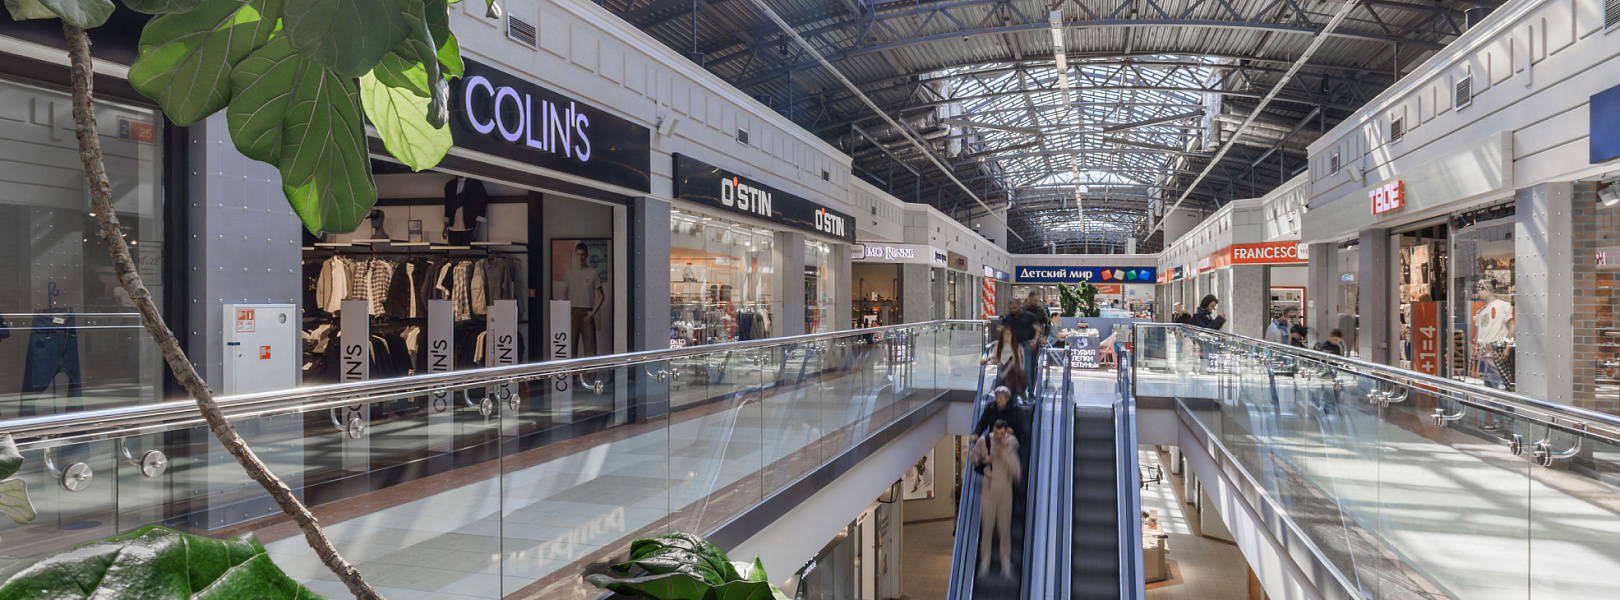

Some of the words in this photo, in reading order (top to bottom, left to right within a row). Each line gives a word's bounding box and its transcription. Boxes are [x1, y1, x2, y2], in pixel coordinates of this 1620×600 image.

[463, 75, 591, 162] COLIN'S
[721, 176, 772, 217] O'STIN
[815, 207, 845, 237] O'STIN
[1234, 246, 1297, 260] FRANCESC
[1020, 268, 1067, 279] Детский
[1069, 270, 1093, 280] мир
[1419, 325, 1436, 376] +1=4
